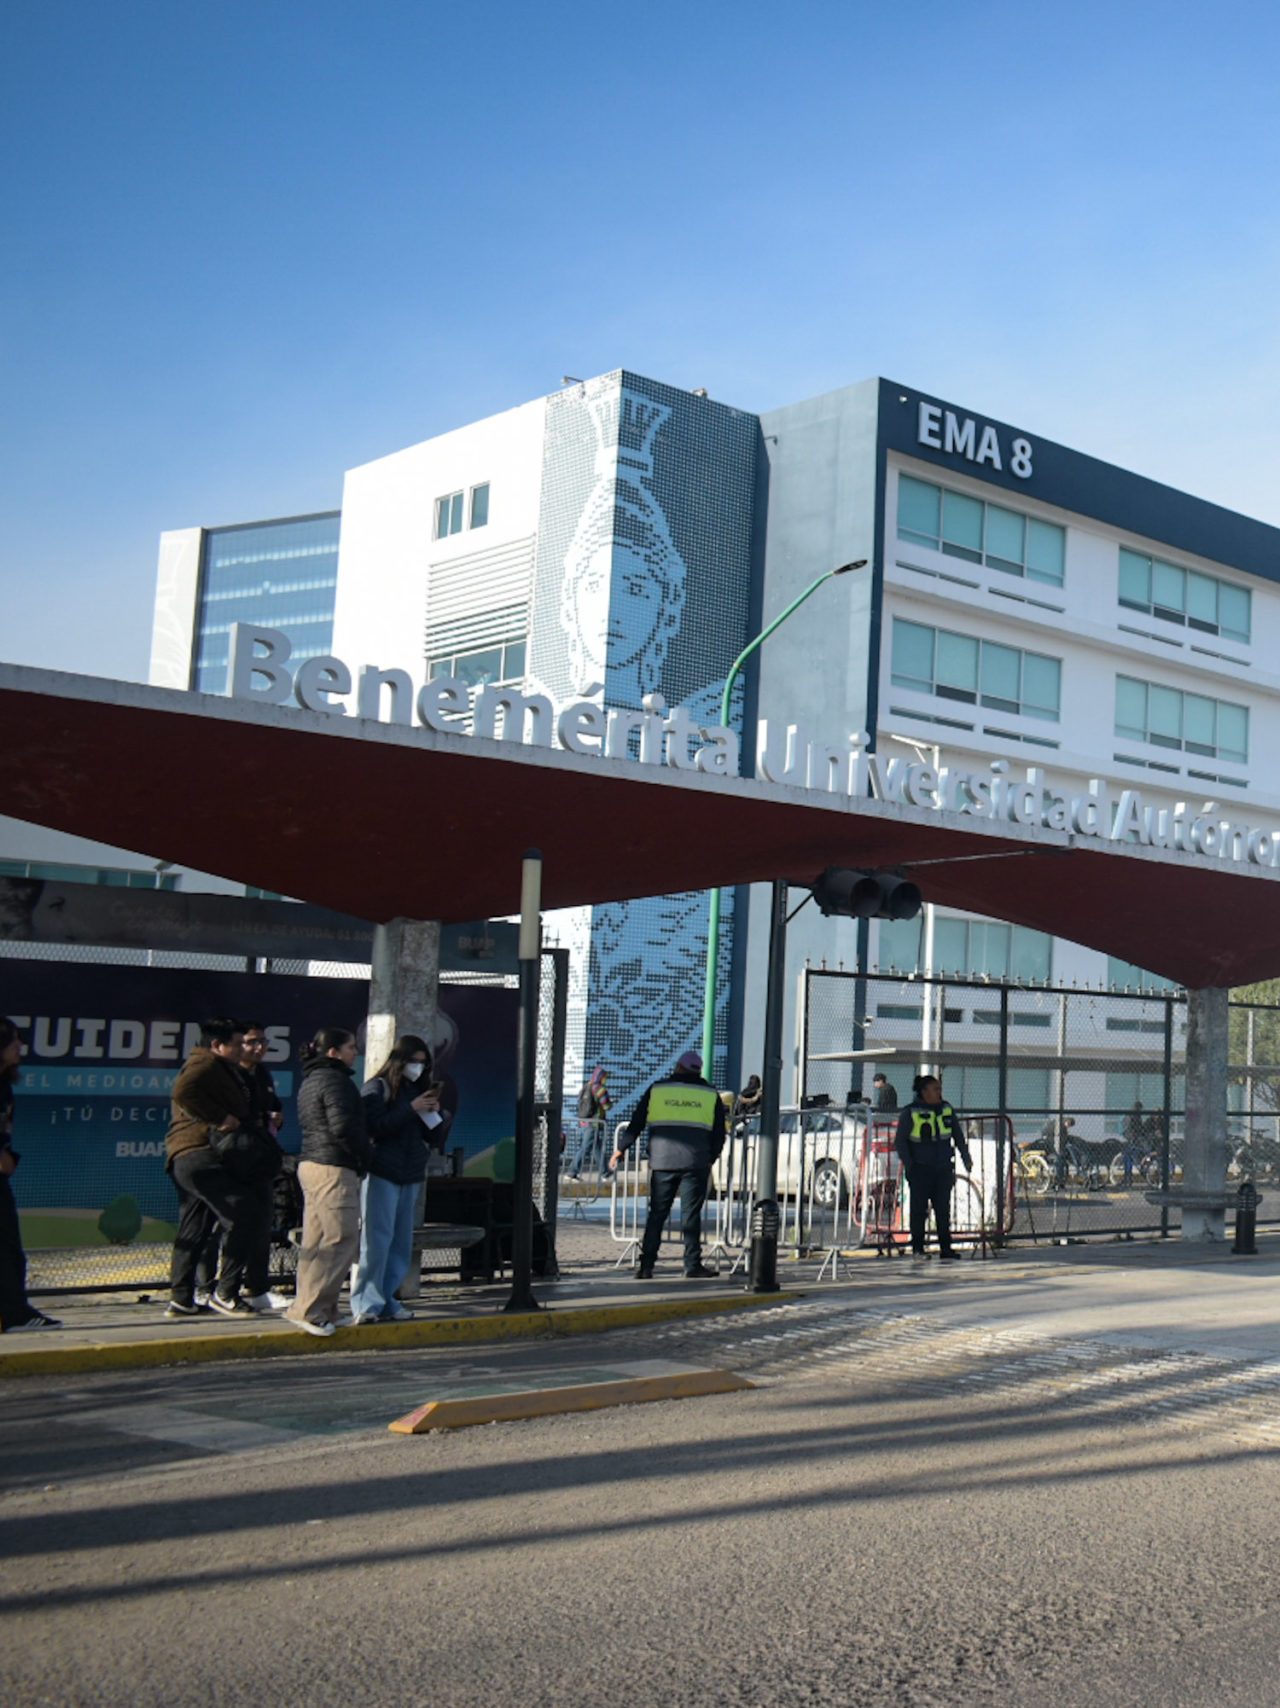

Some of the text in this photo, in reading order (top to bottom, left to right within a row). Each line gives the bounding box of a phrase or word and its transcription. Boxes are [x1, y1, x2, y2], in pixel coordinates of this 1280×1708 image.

[918, 401, 1033, 479] EMA 8
[227, 622, 740, 777] Benemérita
[756, 719, 1107, 836] Universidad
[6, 1015, 291, 1063] UIDES
[25, 1073, 176, 1089] EL MEDIOAM
[51, 1104, 168, 1124] ¡TÚ DECI
